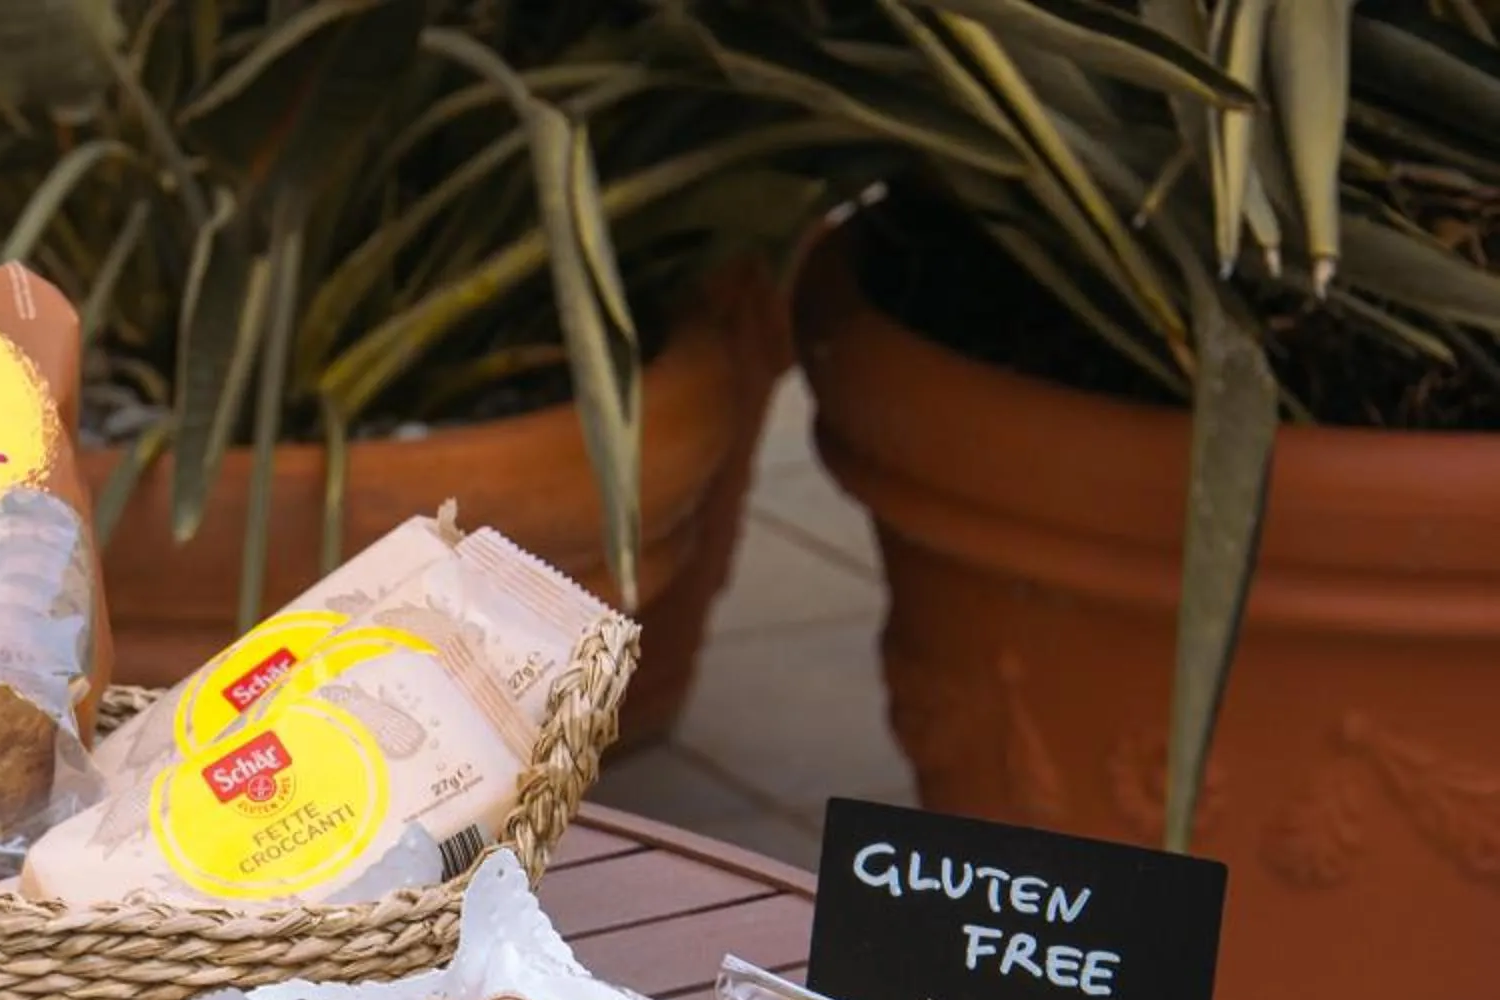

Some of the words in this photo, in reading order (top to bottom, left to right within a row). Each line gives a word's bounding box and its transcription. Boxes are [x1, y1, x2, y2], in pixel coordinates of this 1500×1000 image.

[231, 656, 292, 705] Schär
[212, 744, 283, 793] Schär
[238, 803, 357, 876] CROCCANTI
[252, 799, 321, 848] FETTE
[853, 842, 1092, 923] GLUTEN
[962, 924, 1121, 997] FREE
